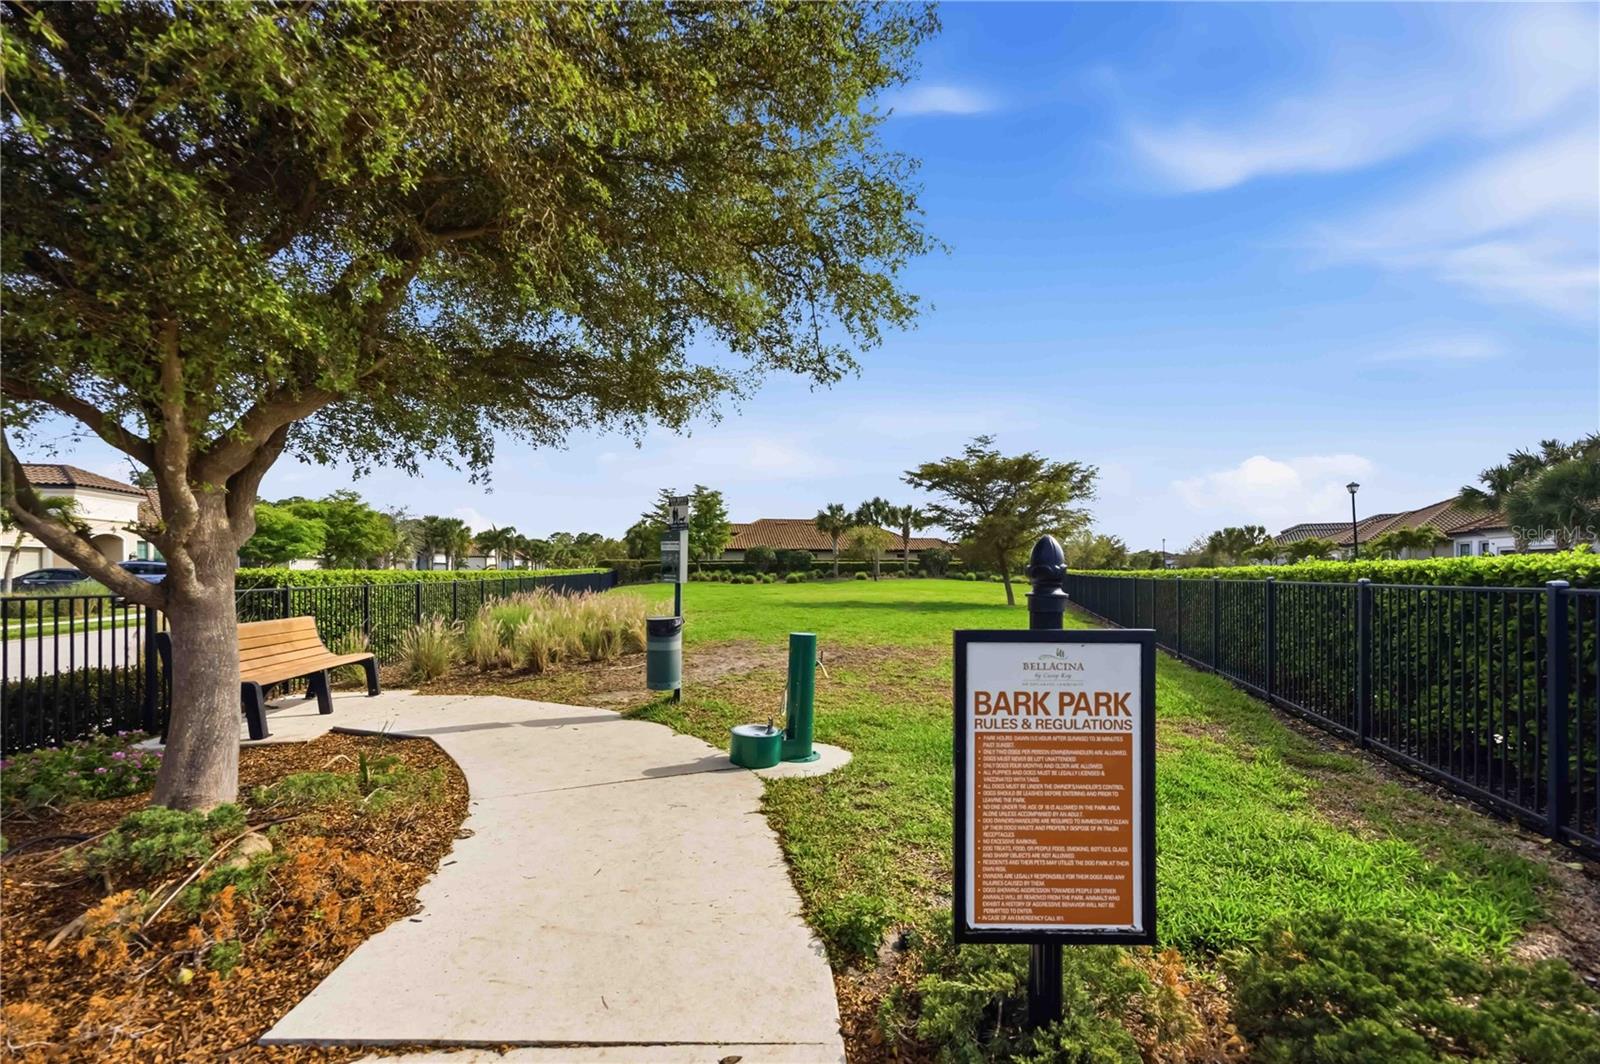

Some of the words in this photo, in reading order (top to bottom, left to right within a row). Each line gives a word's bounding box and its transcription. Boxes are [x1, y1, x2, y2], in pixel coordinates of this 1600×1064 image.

[1023, 662, 1084, 671] BELLACINA
[974, 691, 1052, 717] BARK
[1058, 692, 1133, 717] PARK
[974, 718, 1018, 729] RULES
[1021, 718, 1032, 729] &
[1035, 718, 1133, 731] REGULATIONS
